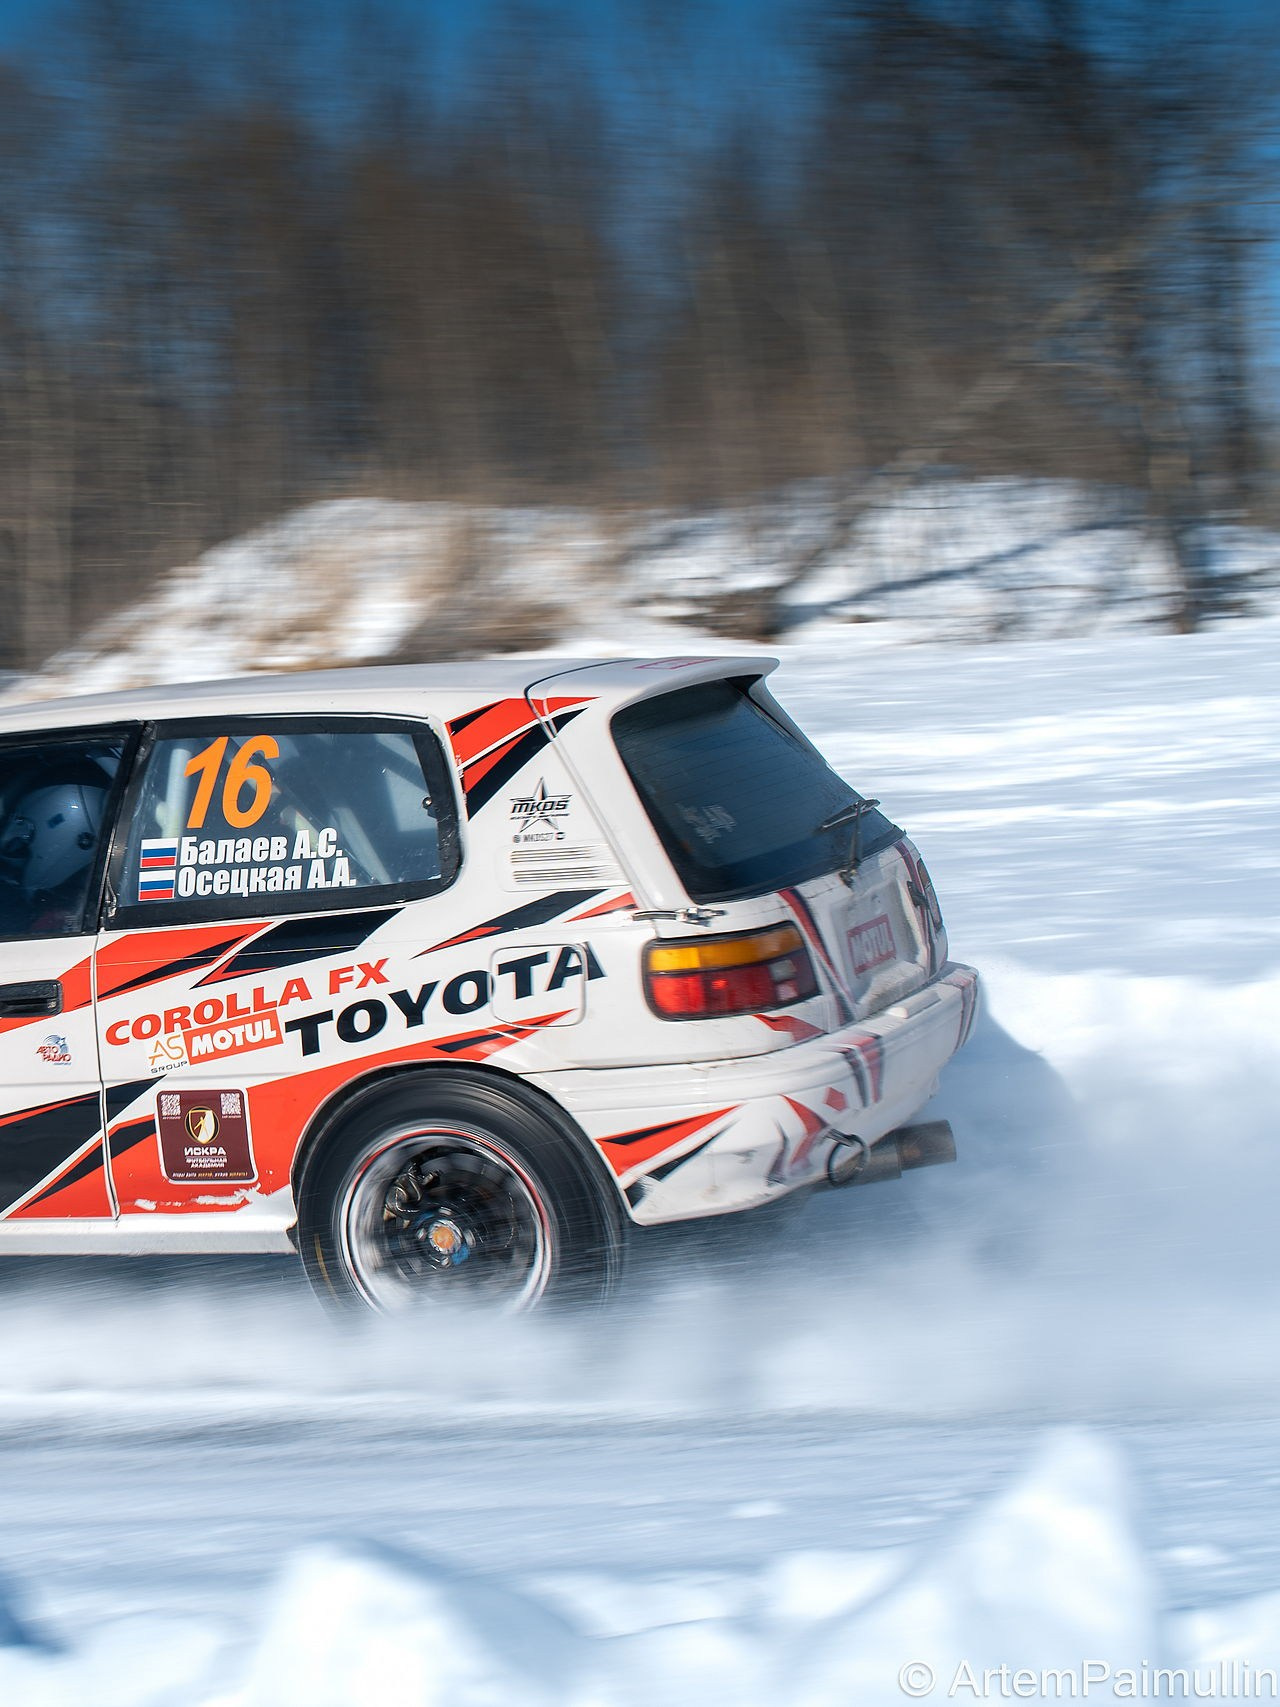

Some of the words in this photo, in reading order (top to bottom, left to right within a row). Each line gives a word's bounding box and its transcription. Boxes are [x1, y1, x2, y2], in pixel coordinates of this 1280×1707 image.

[183, 735, 280, 829] 16
[179, 835, 288, 866] Балаев
[292, 827, 343, 860] А.С.
[177, 865, 303, 897] Осецкая
[306, 856, 357, 890] А.А.
[105, 976, 313, 1047] COROLLA
[328, 958, 391, 996] FX
[284, 941, 608, 1057] TOYOTA
[148, 1034, 185, 1066] AS
[191, 1017, 277, 1058] MOTUL
[150, 1059, 189, 1074] GROUP
[183, 1146, 227, 1156] ИСКРА
